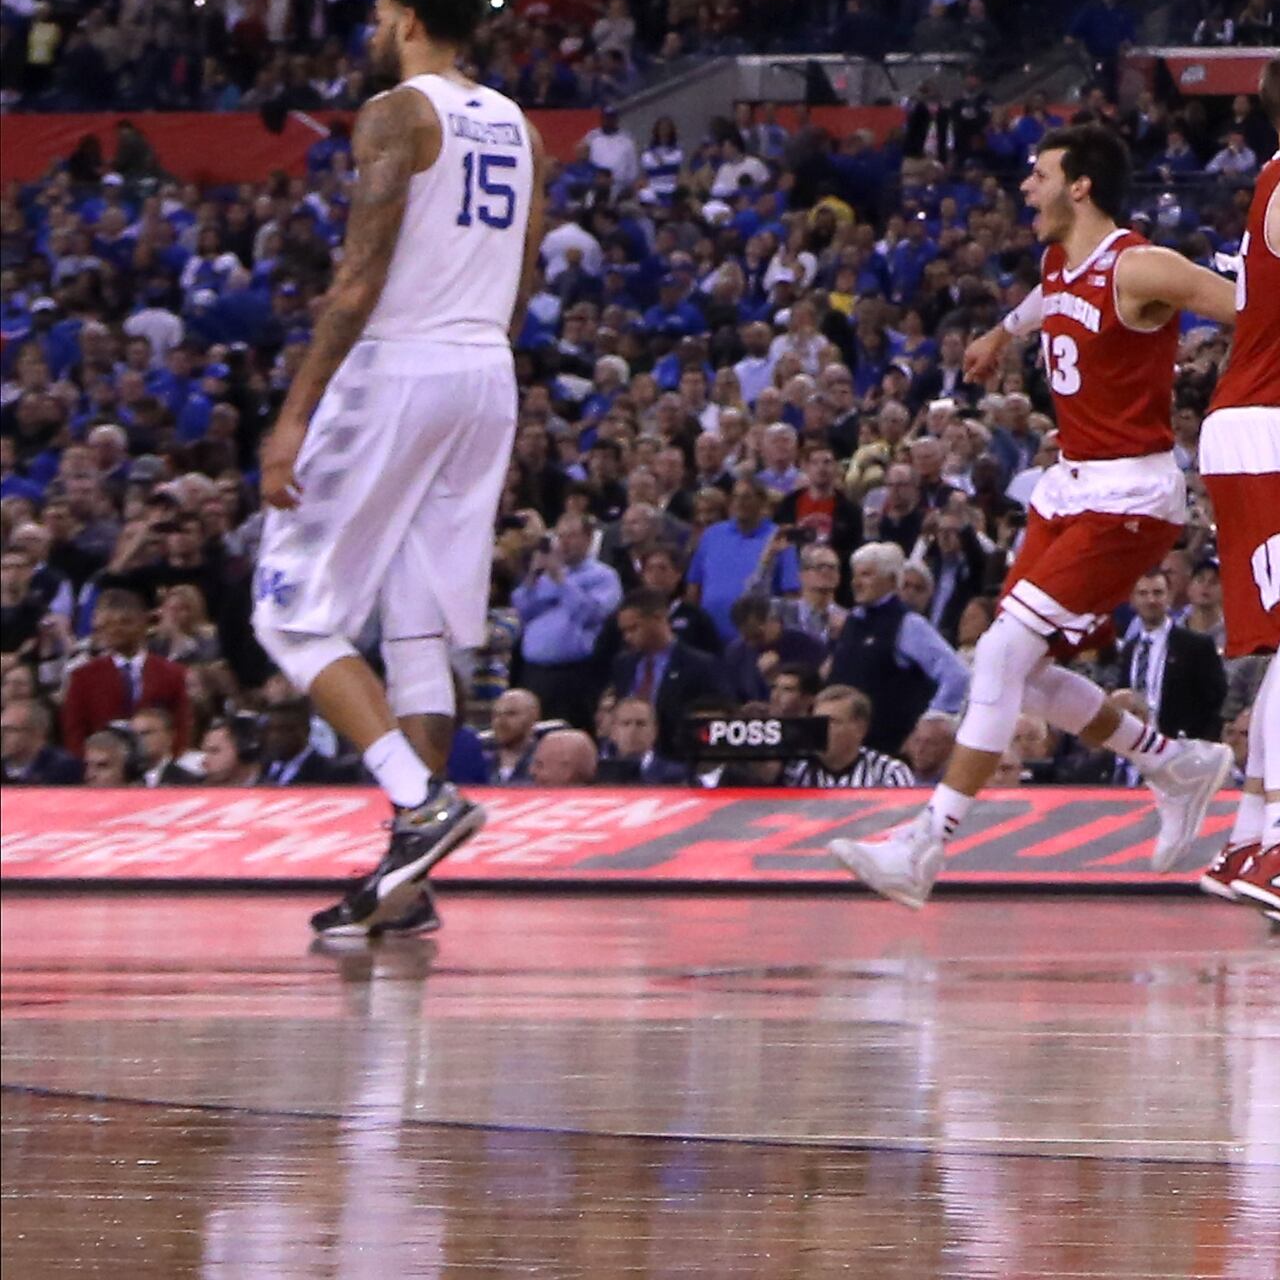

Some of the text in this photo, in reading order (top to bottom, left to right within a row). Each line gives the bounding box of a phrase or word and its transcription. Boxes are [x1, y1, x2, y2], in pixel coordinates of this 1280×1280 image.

[457, 152, 517, 230] 15
[708, 720, 782, 746] POSS
[100, 796, 369, 829] AND
[480, 796, 705, 829] HEN
[0, 830, 247, 863] ERE
